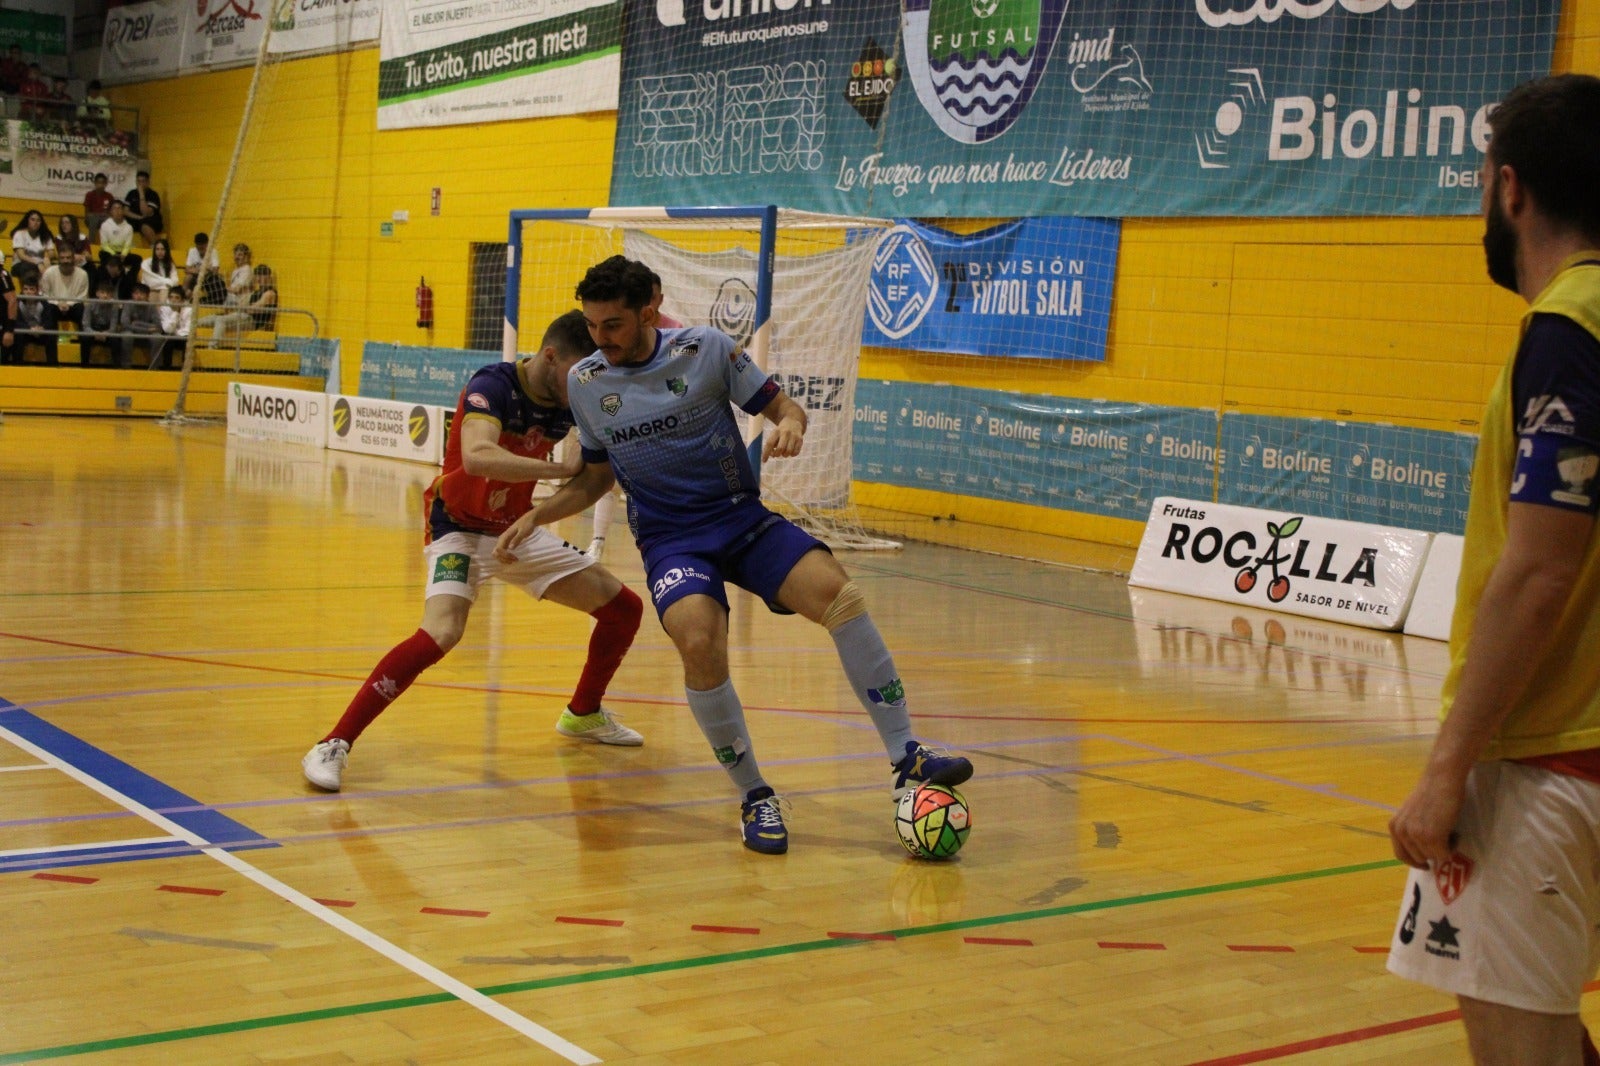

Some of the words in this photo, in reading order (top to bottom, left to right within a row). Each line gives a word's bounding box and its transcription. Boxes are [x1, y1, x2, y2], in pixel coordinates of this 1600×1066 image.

[702, 20, 828, 46] #Elfuturoquenosune
[933, 27, 1032, 49] FUTSAL
[404, 60, 421, 87] Tu
[425, 52, 468, 83] éxito,
[472, 37, 537, 72] nuestra
[543, 22, 588, 56] meta
[1068, 28, 1115, 64] imd
[849, 81, 861, 96] EL
[864, 78, 894, 95] EJIDO
[1268, 88, 1498, 161] Bioline
[834, 155, 858, 192] La
[859, 152, 926, 197] Fuerza
[927, 164, 966, 194] que
[966, 161, 1000, 183] nos
[1002, 152, 1048, 182] hace
[1048, 145, 1132, 186] Líderes
[1438, 165, 1480, 188] Iber
[888, 263, 911, 279] RF
[969, 256, 1084, 275] DIVISIÓN
[887, 285, 909, 301] EF
[971, 275, 1029, 315] FÚTBOL
[1036, 279, 1082, 316] SALA
[356, 407, 404, 421] NEUMÁTICOS
[912, 409, 961, 431] Bioline
[356, 419, 375, 431] PACO
[377, 422, 404, 435] RAMOS
[988, 417, 1041, 441] Bioline
[1070, 426, 1128, 450] Bioline
[1160, 436, 1226, 464] Bioline
[1262, 448, 1331, 474] Bioline
[1371, 457, 1447, 489] Bioline
[1163, 504, 1206, 520] Frutas
[1161, 522, 1379, 588] ROCALLA
[1296, 592, 1332, 607] SABOR
[1337, 599, 1352, 610] DE
[1356, 602, 1389, 616] NIVEL
